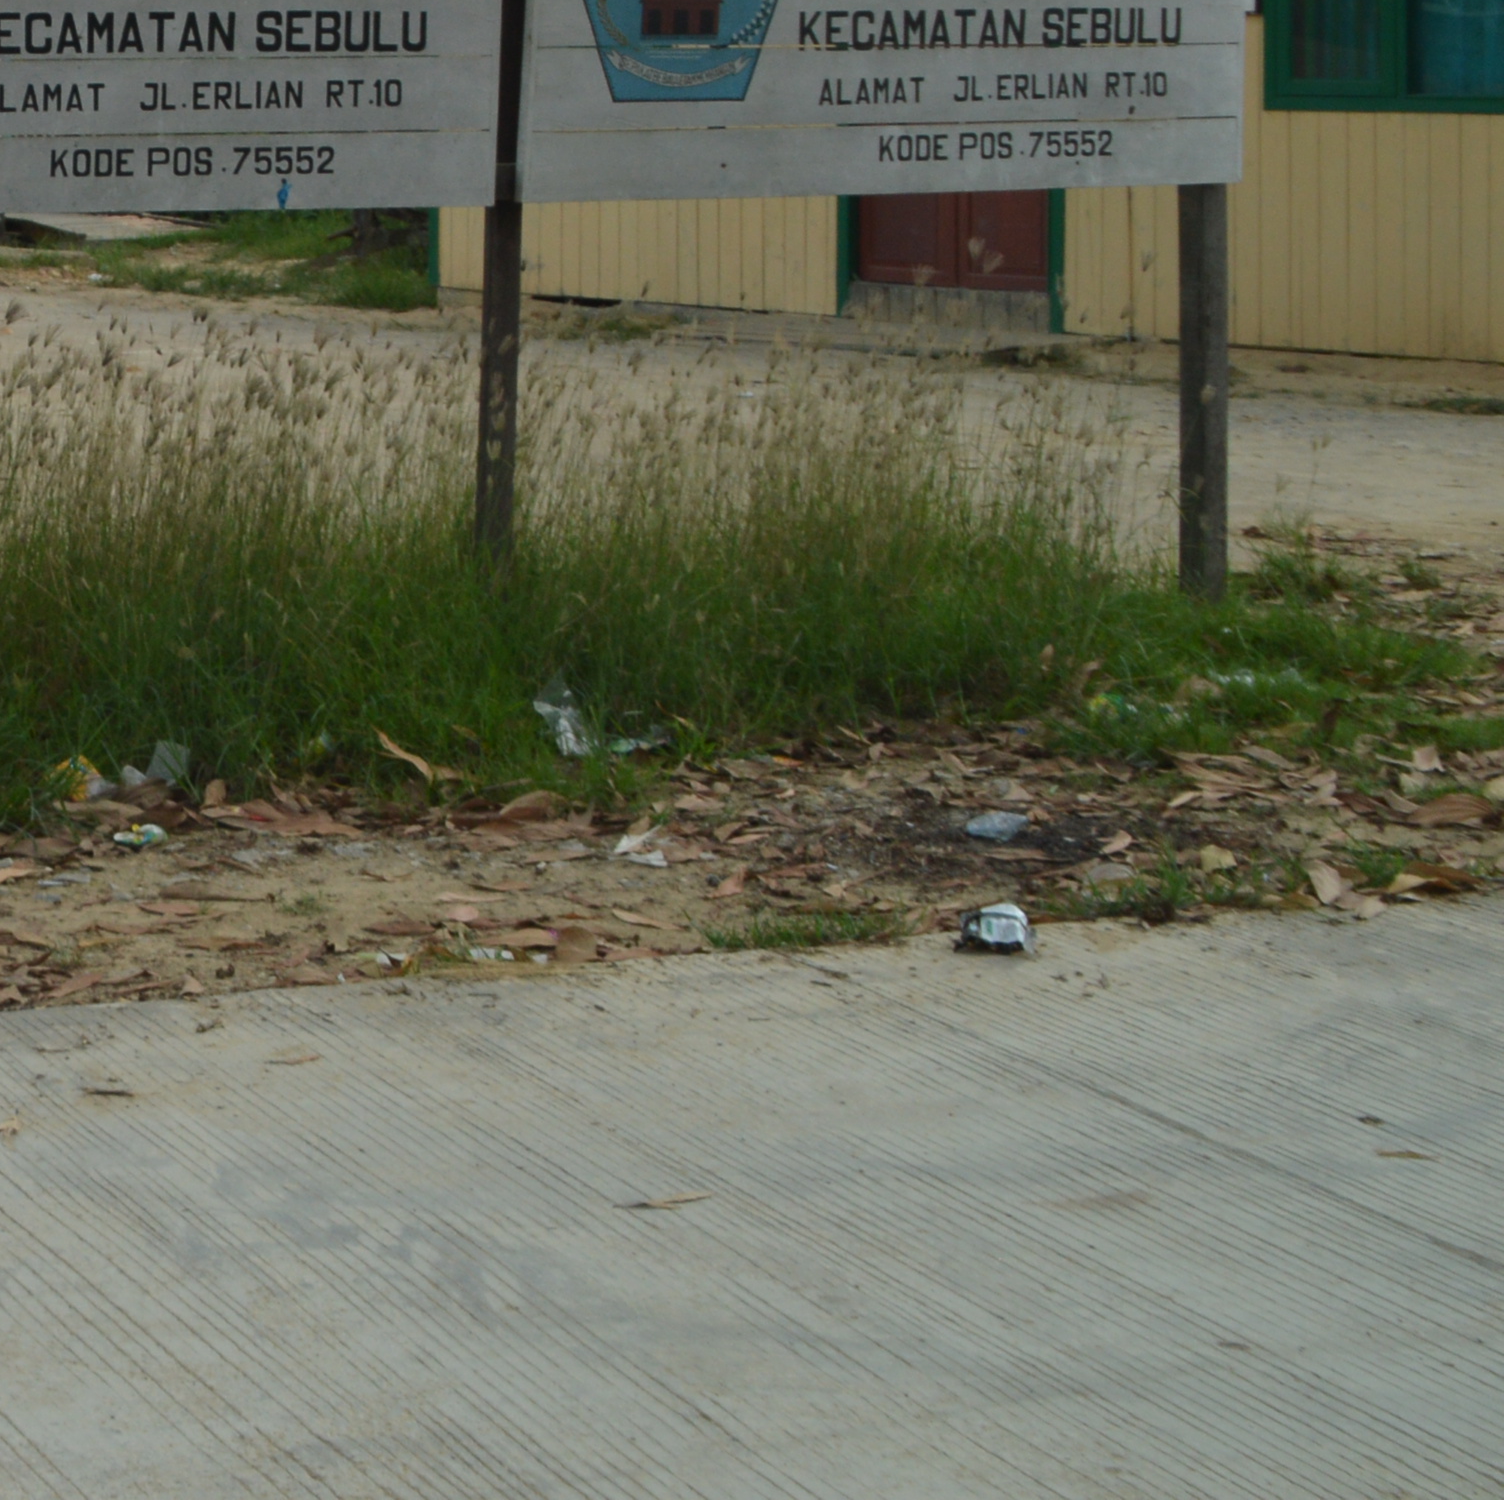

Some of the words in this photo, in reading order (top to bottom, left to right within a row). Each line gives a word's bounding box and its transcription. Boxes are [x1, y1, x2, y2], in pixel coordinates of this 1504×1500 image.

[255, 10, 429, 53] SEBULU
[797, 8, 1026, 52] KECAMATAN
[1042, 6, 1183, 49] SEBULU
[818, 76, 926, 106] ALAMAT
[48, 147, 135, 179] KODE
[877, 133, 950, 163] KODE
